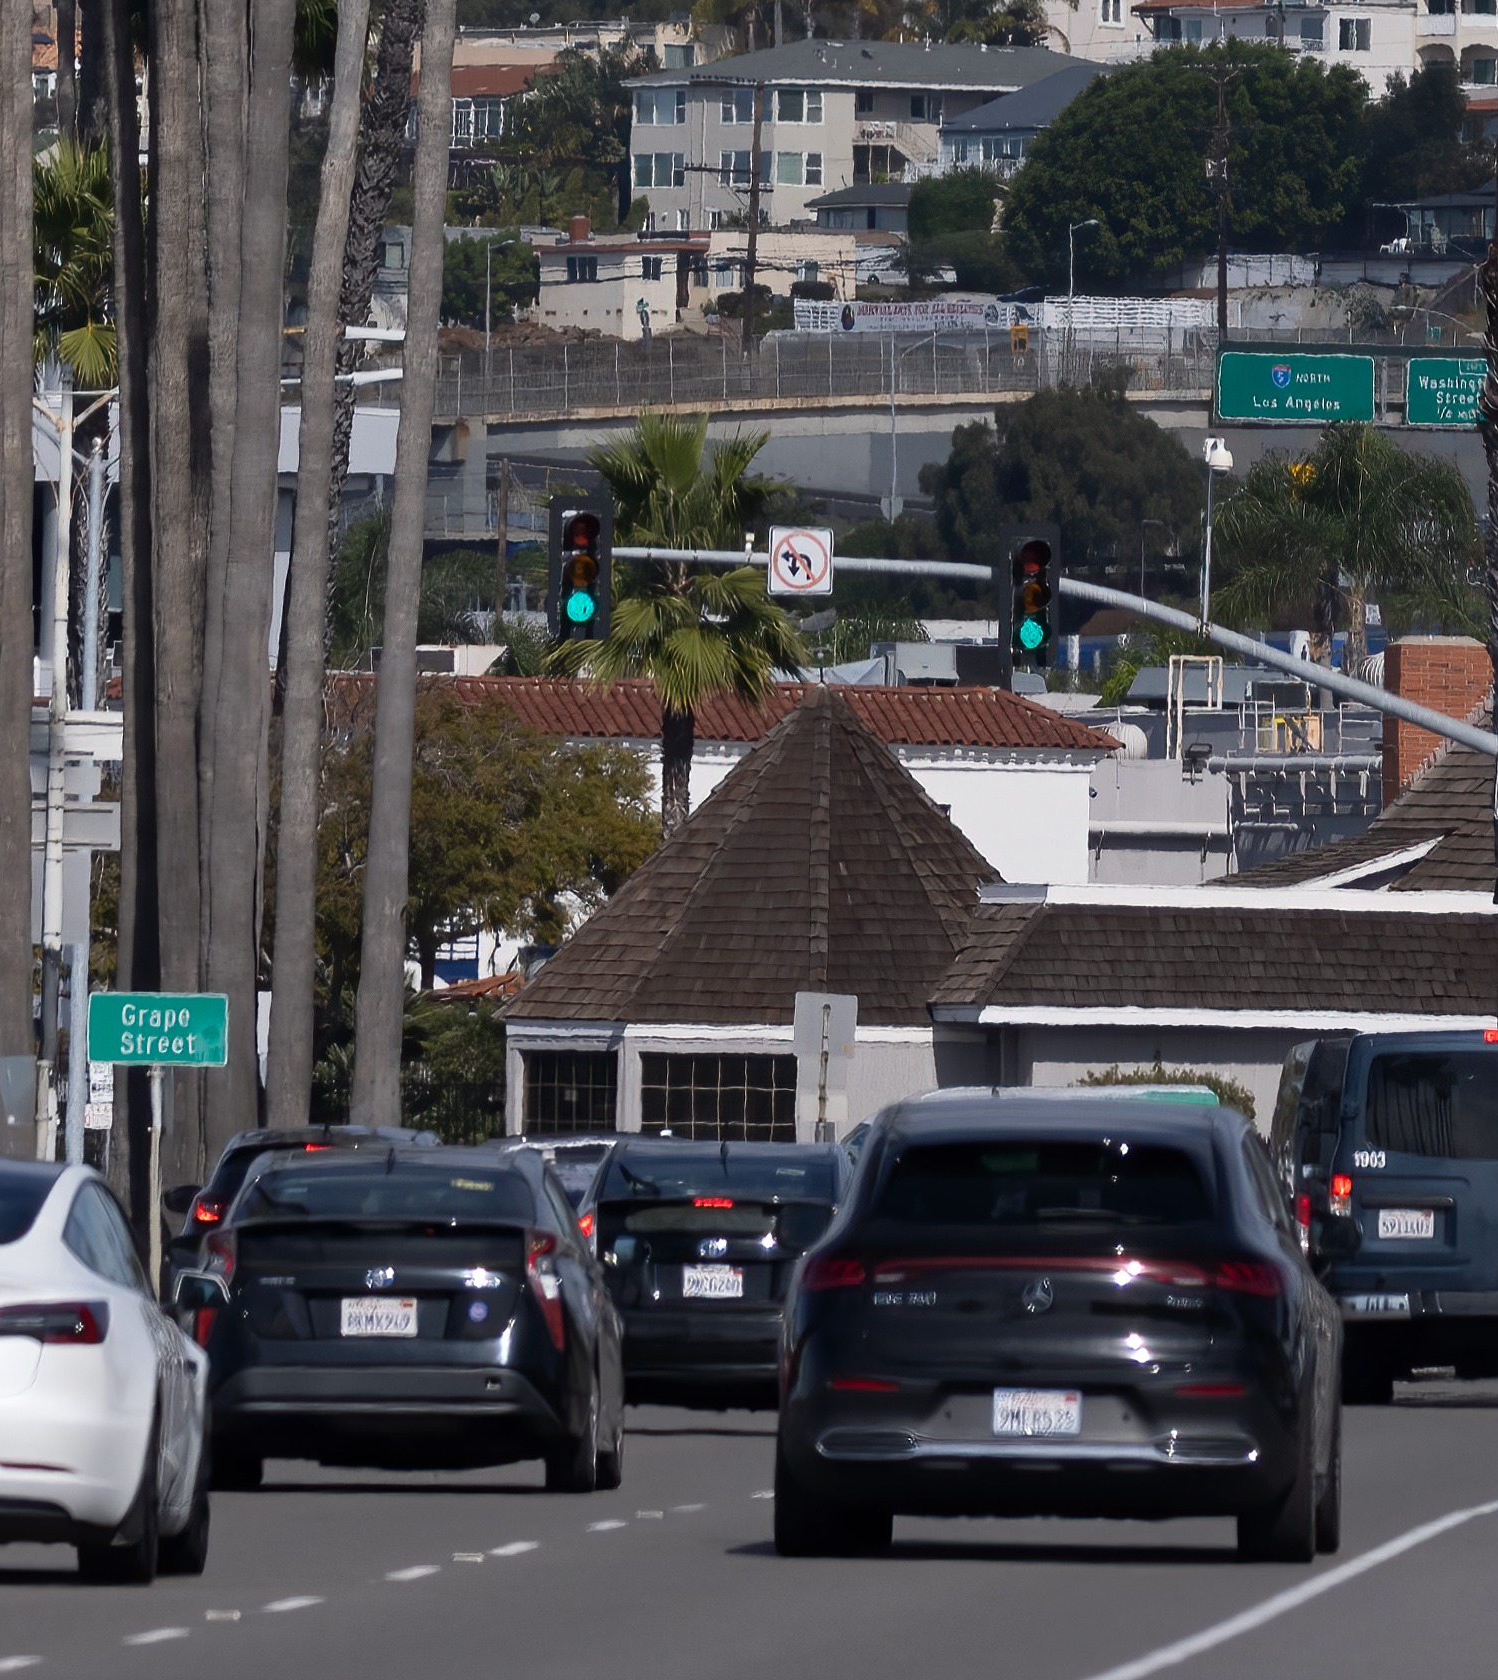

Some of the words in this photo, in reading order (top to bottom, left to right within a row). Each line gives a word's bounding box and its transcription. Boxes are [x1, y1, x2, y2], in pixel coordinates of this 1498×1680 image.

[1295, 372, 1331, 384] NORTH
[1419, 375, 1485, 392] Washingt
[1253, 396, 1278, 408] Los
[1285, 396, 1341, 412] Angeles
[1436, 391, 1481, 405] Street
[121, 1003, 191, 1033] Grape
[120, 1030, 197, 1055] Street
[1353, 1150, 1386, 1169] 1903
